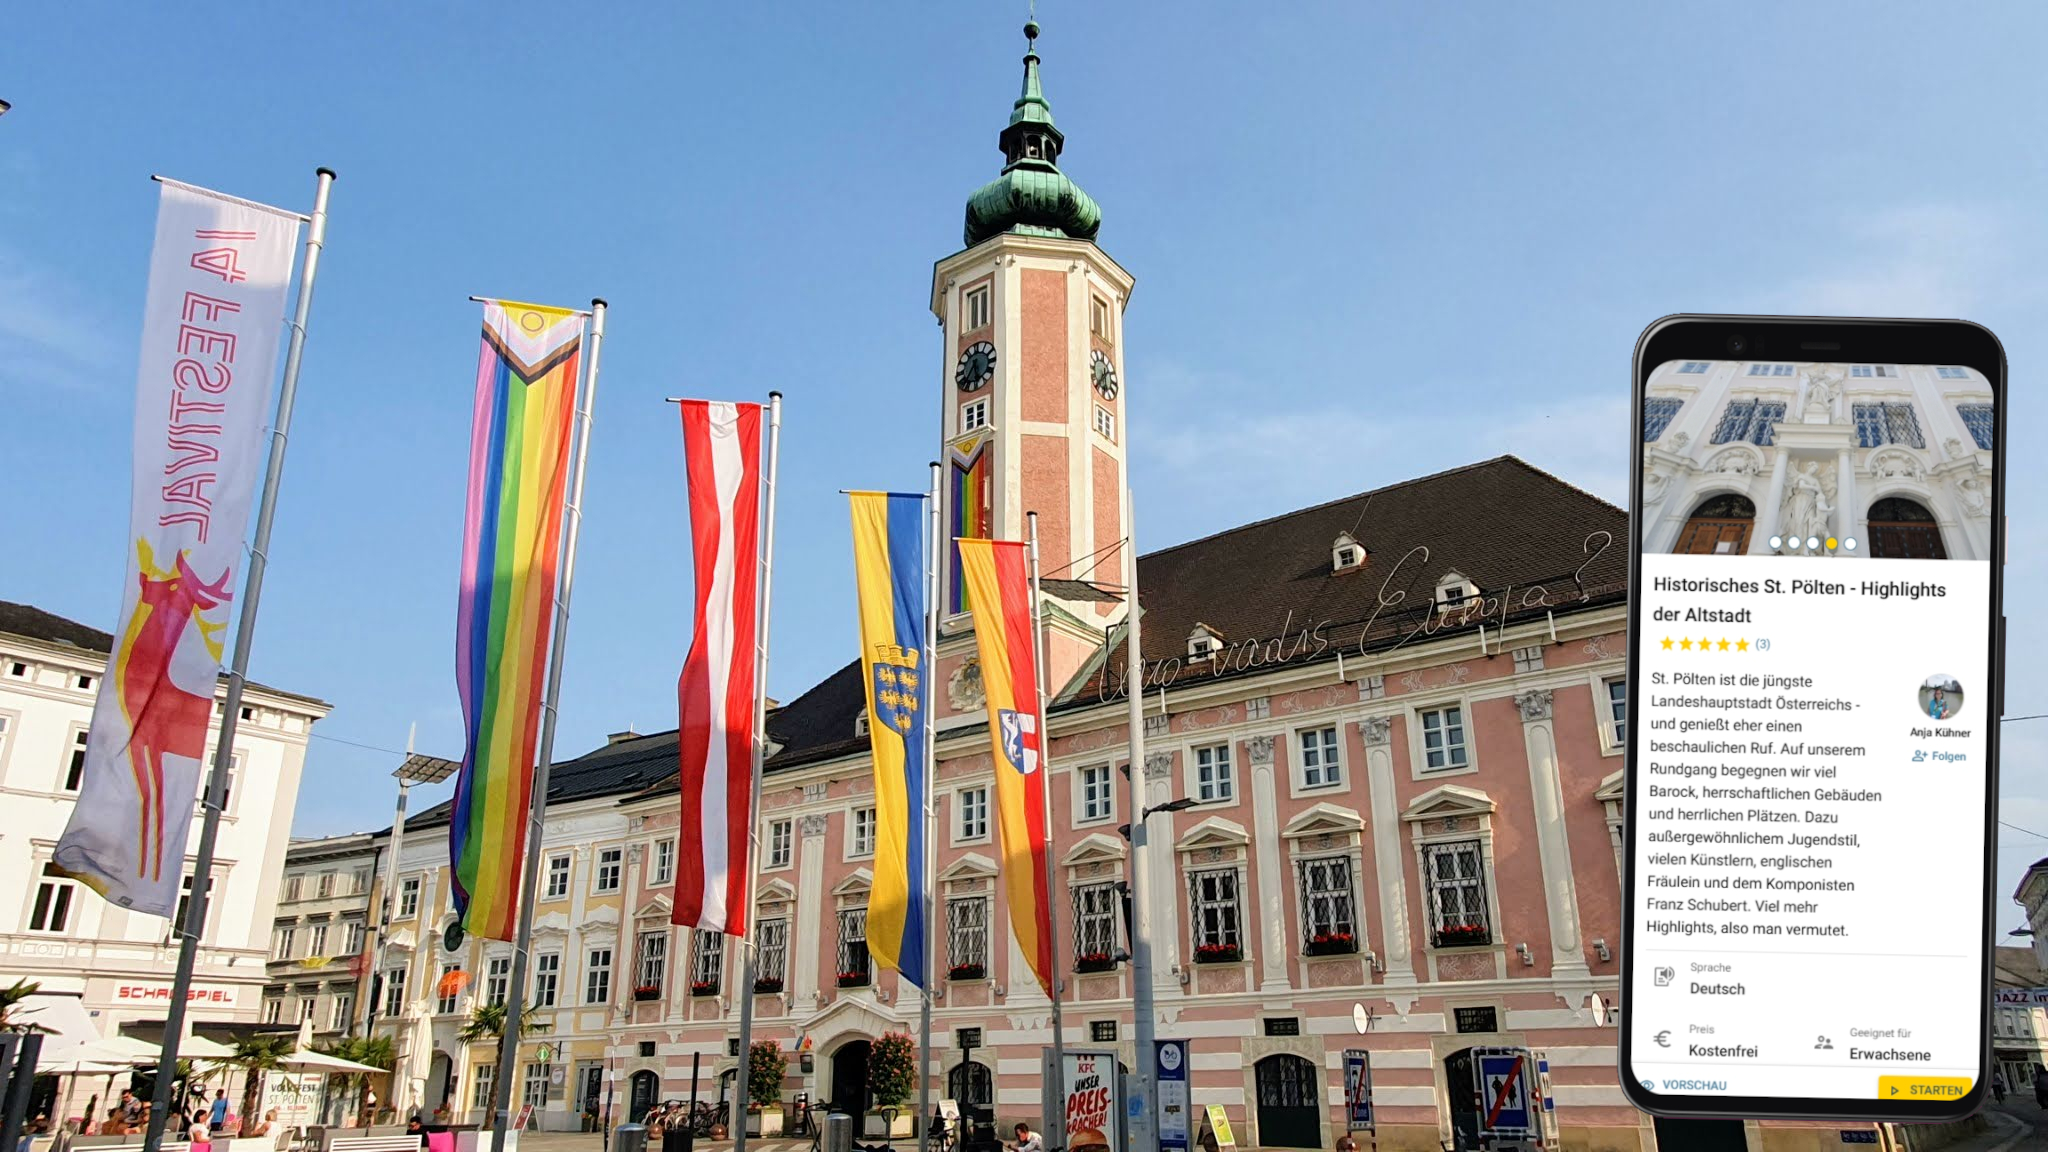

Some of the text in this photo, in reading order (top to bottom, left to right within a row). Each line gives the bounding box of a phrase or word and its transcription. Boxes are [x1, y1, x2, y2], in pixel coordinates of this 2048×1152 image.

[1654, 577, 1759, 593] Historisches
[1764, 579, 1785, 593] St.
[1792, 580, 1845, 595] Pölten
[1862, 581, 1946, 600] Highlights
[1653, 606, 1751, 623] der Altstadt
[1213, 609, 1331, 677] vadis
[1756, 639, 1770, 651] (3)
[1652, 672, 1812, 690] St. Pölten ist die jüngste
[1652, 695, 1771, 710] Landeshauptstadt
[1776, 696, 1851, 711] Österreichs
[1651, 718, 1802, 733] und genießt eher einen
[1910, 728, 1971, 739] Anja Kühner
[1651, 740, 1865, 756] beschaulichen Ruf. Auf unserem
[1933, 752, 1966, 762] Folgen
[1650, 762, 1836, 779] Rundgang begegnen wir viel
[1650, 785, 1881, 801] Barock, herrschaftlichen Gebäuden
[1649, 808, 1838, 823] und herrlichen Plätzen. Dazu
[1649, 830, 1860, 848] außergewöhnlichem Jugendstil,
[1648, 853, 1832, 870] vielen Künstlern, englischen
[1648, 875, 1854, 892] Fräulein und dem Komponisten
[1648, 898, 1818, 913] Franz Schubert. Viel mehr
[1647, 921, 1848, 936] Highlights, also man vermutet.
[1691, 962, 1731, 973] Sprache
[1691, 982, 1745, 995] Deutsch
[1690, 1024, 1714, 1034] Preis
[1850, 1028, 1911, 1039] Geeignet für
[1689, 1045, 1757, 1057] Kostenfrei
[1850, 1048, 1931, 1061] Erwachsene
[1078, 1063, 1095, 1073] KFC
[1075, 1075, 1099, 1092] UNSER
[1663, 1080, 1726, 1090] VORSCHAU
[1910, 1084, 1963, 1095] STARTEN
[1066, 1087, 1111, 1119] PREIS-
